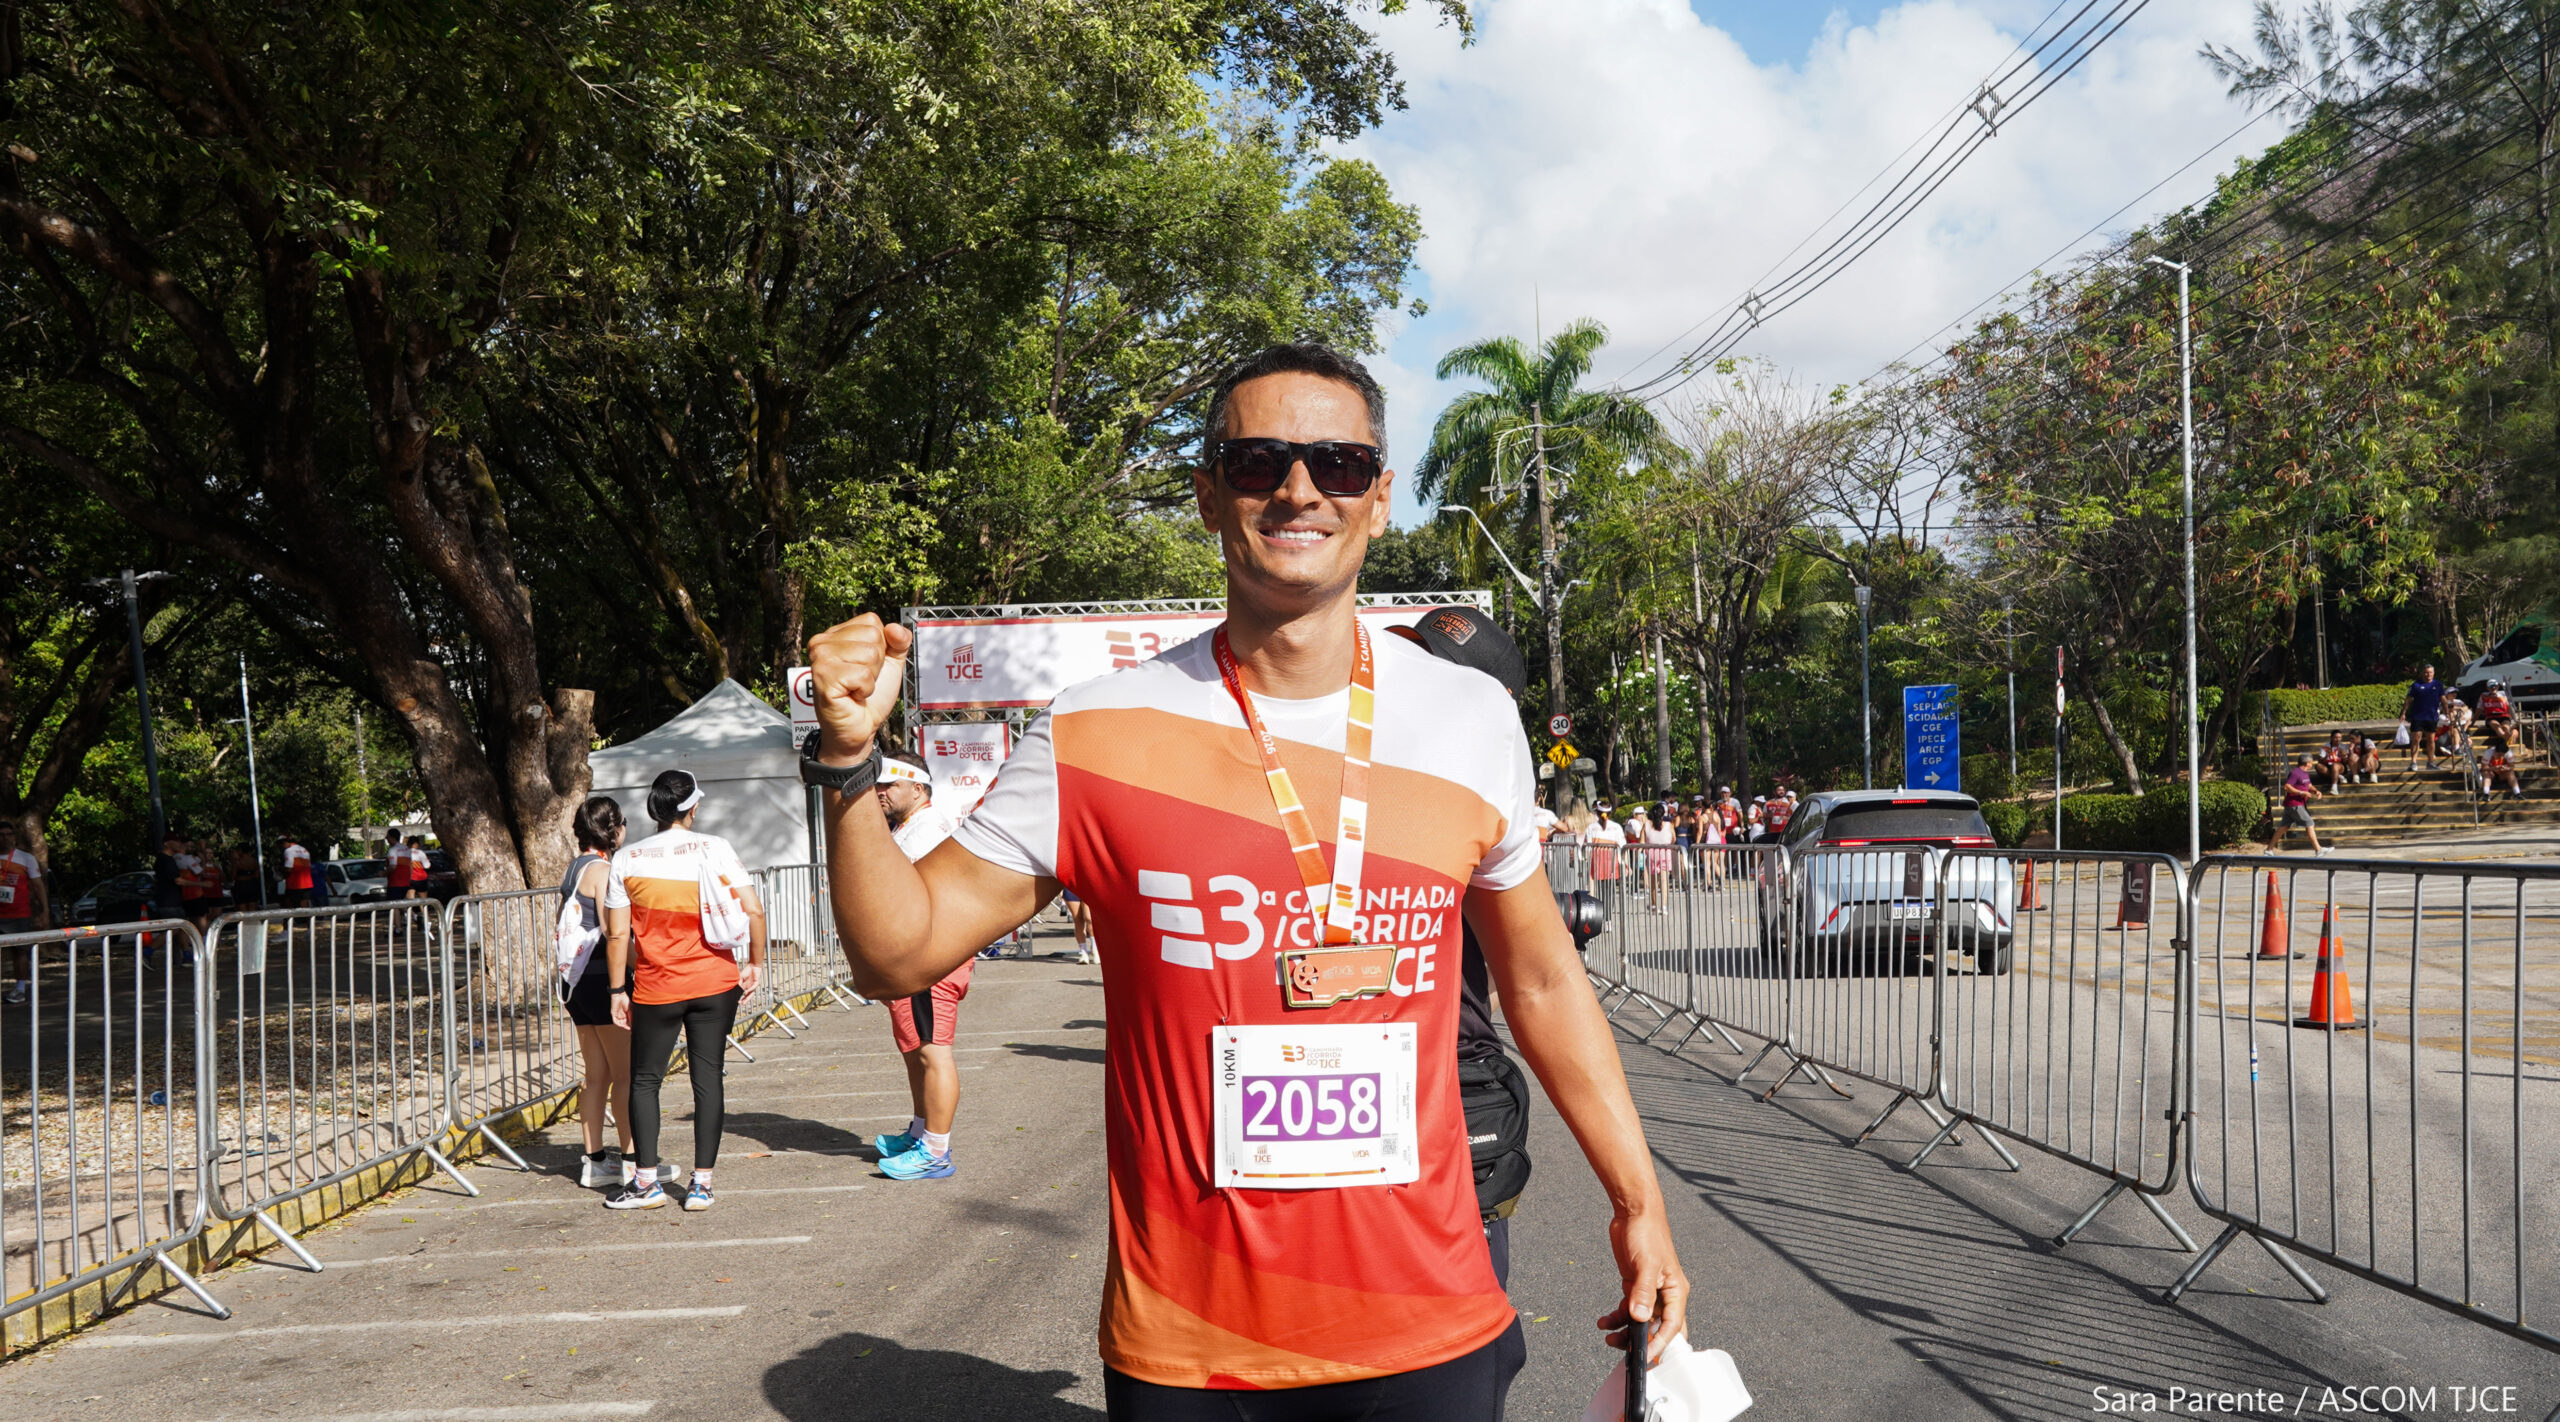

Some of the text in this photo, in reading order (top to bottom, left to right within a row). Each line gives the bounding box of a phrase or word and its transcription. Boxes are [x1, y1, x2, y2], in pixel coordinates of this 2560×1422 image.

[945, 664, 983, 680] TJCE
[1926, 690, 1937, 699] TJ
[1553, 719, 1569, 729] 30
[1922, 723, 1942, 732] CGE
[1918, 734, 1946, 743] IPECE
[1919, 745, 1945, 754] ARCE
[971, 752, 994, 761] TJCE
[1923, 756, 1942, 765] EGP
[1285, 886, 1455, 914] CINHADA
[1273, 911, 1444, 948] /CRRIDA
[1224, 1049, 1236, 1088] 10KM
[1319, 1059, 1341, 1069] TJCE
[1246, 1077, 1378, 1136] 2058
[1467, 1132, 1498, 1145] Canon
[1254, 1154, 1272, 1163] TJCE
